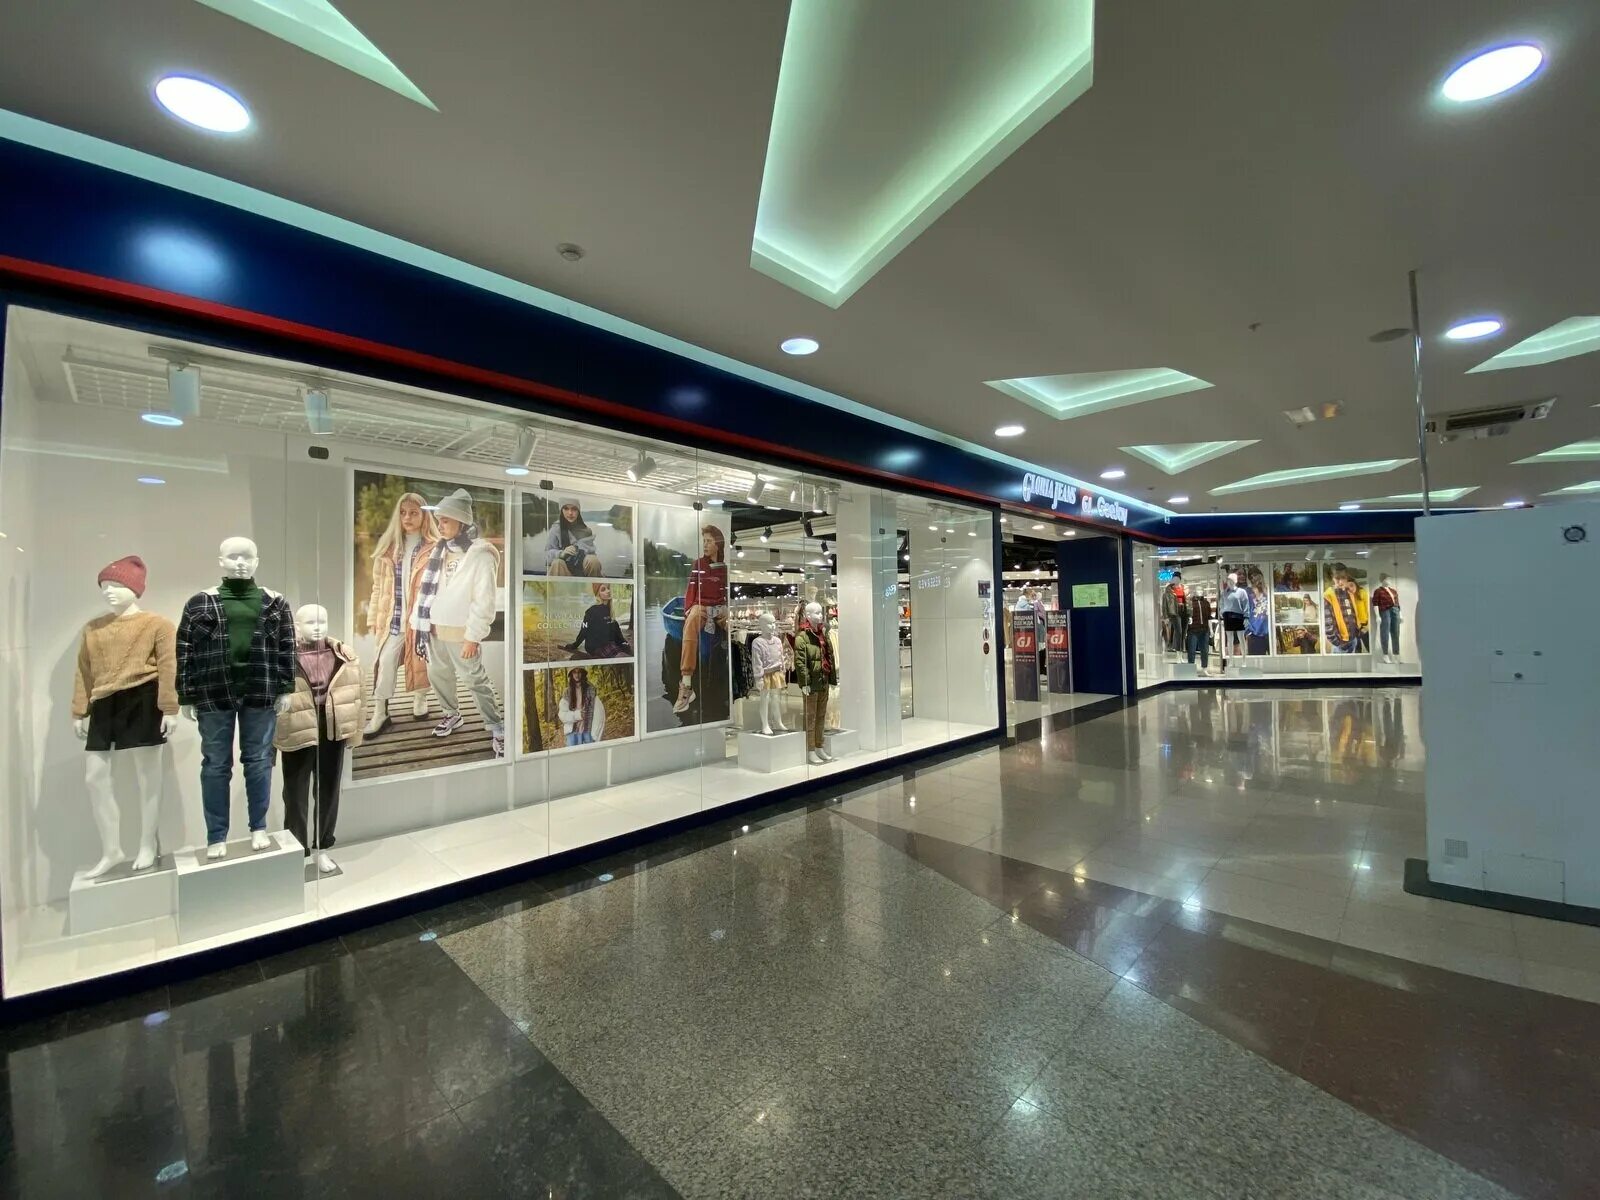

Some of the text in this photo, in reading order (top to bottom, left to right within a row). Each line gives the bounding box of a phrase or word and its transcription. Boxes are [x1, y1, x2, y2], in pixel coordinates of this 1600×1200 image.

[1023, 473, 1077, 510] GLORIA JEANS
[537, 621, 587, 629] COLLECTION
[1017, 637, 1031, 647] GJ
[1050, 634, 1064, 644] GJ
